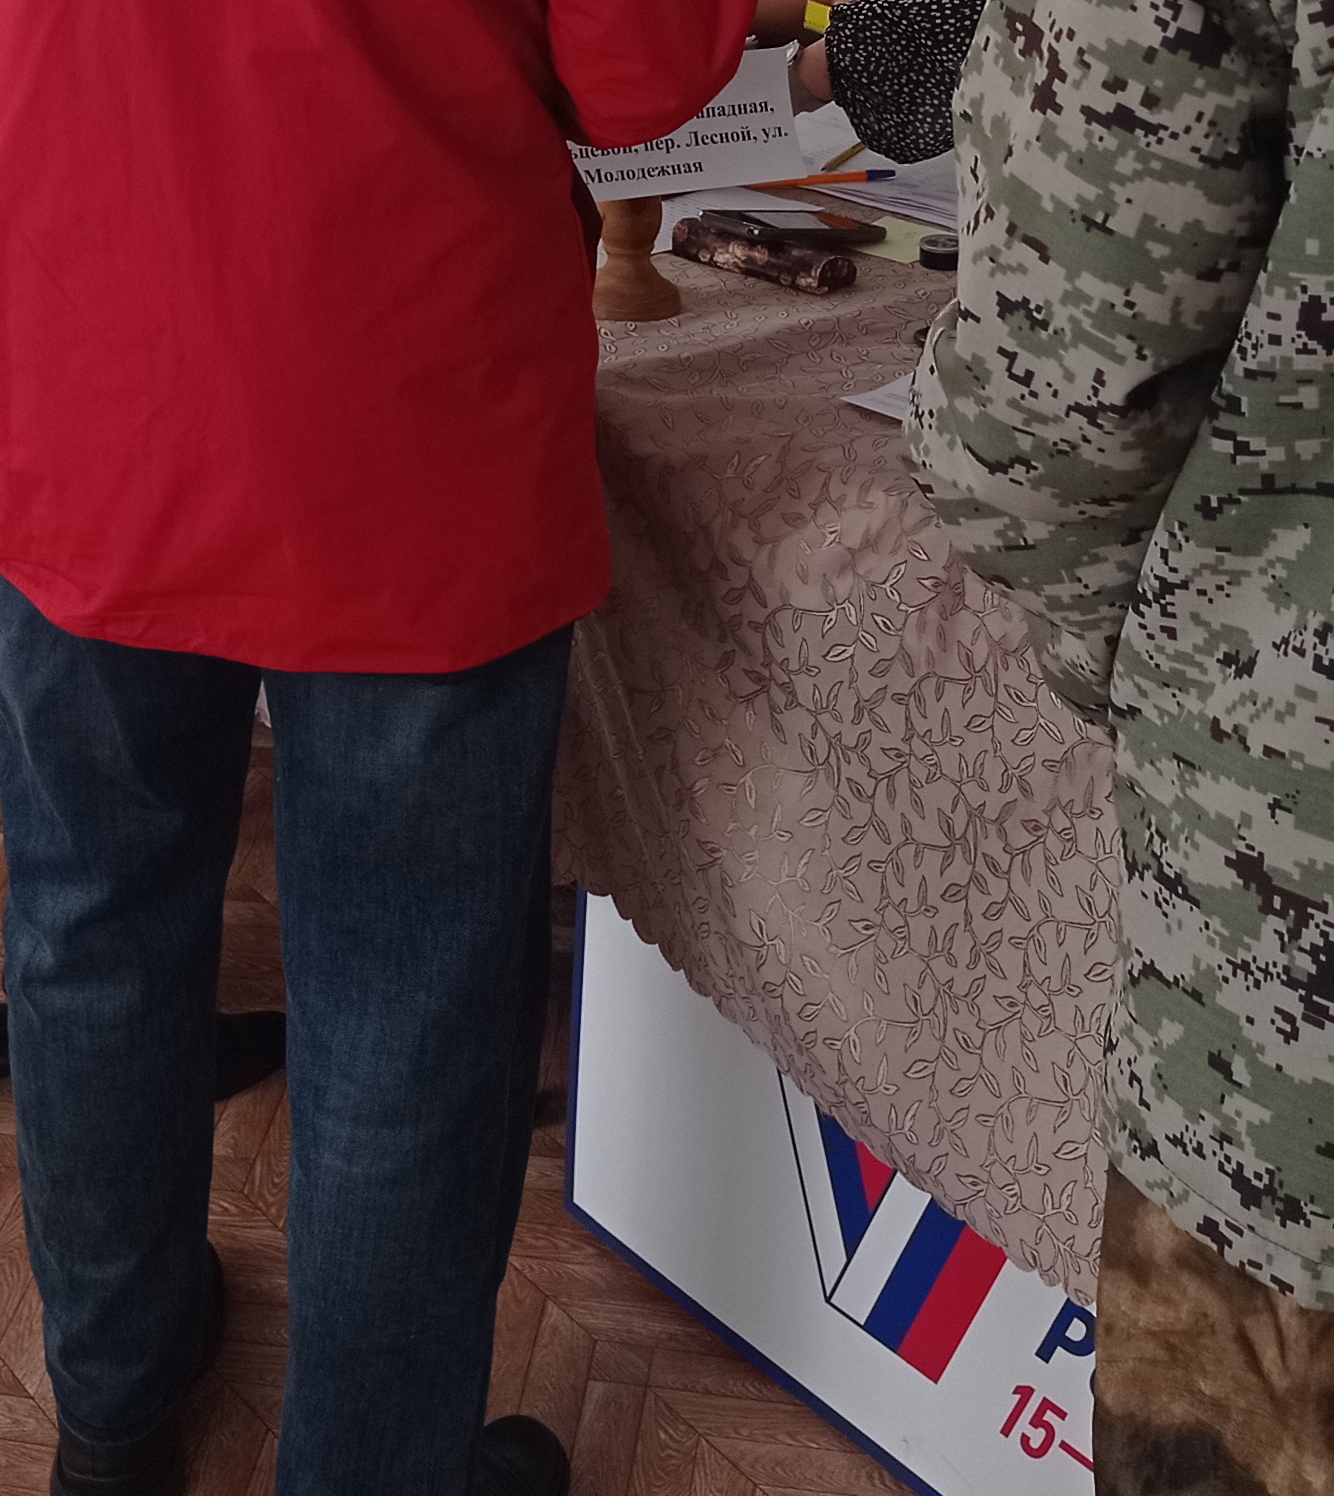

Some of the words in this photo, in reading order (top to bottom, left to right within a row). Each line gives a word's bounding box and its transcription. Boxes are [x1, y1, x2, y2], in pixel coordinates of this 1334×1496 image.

[695, 101, 775, 120] ападная,
[644, 137, 681, 154] пер.
[685, 125, 758, 148] Лесной,
[761, 126, 789, 143] ул.
[584, 161, 704, 185] Молодежная
